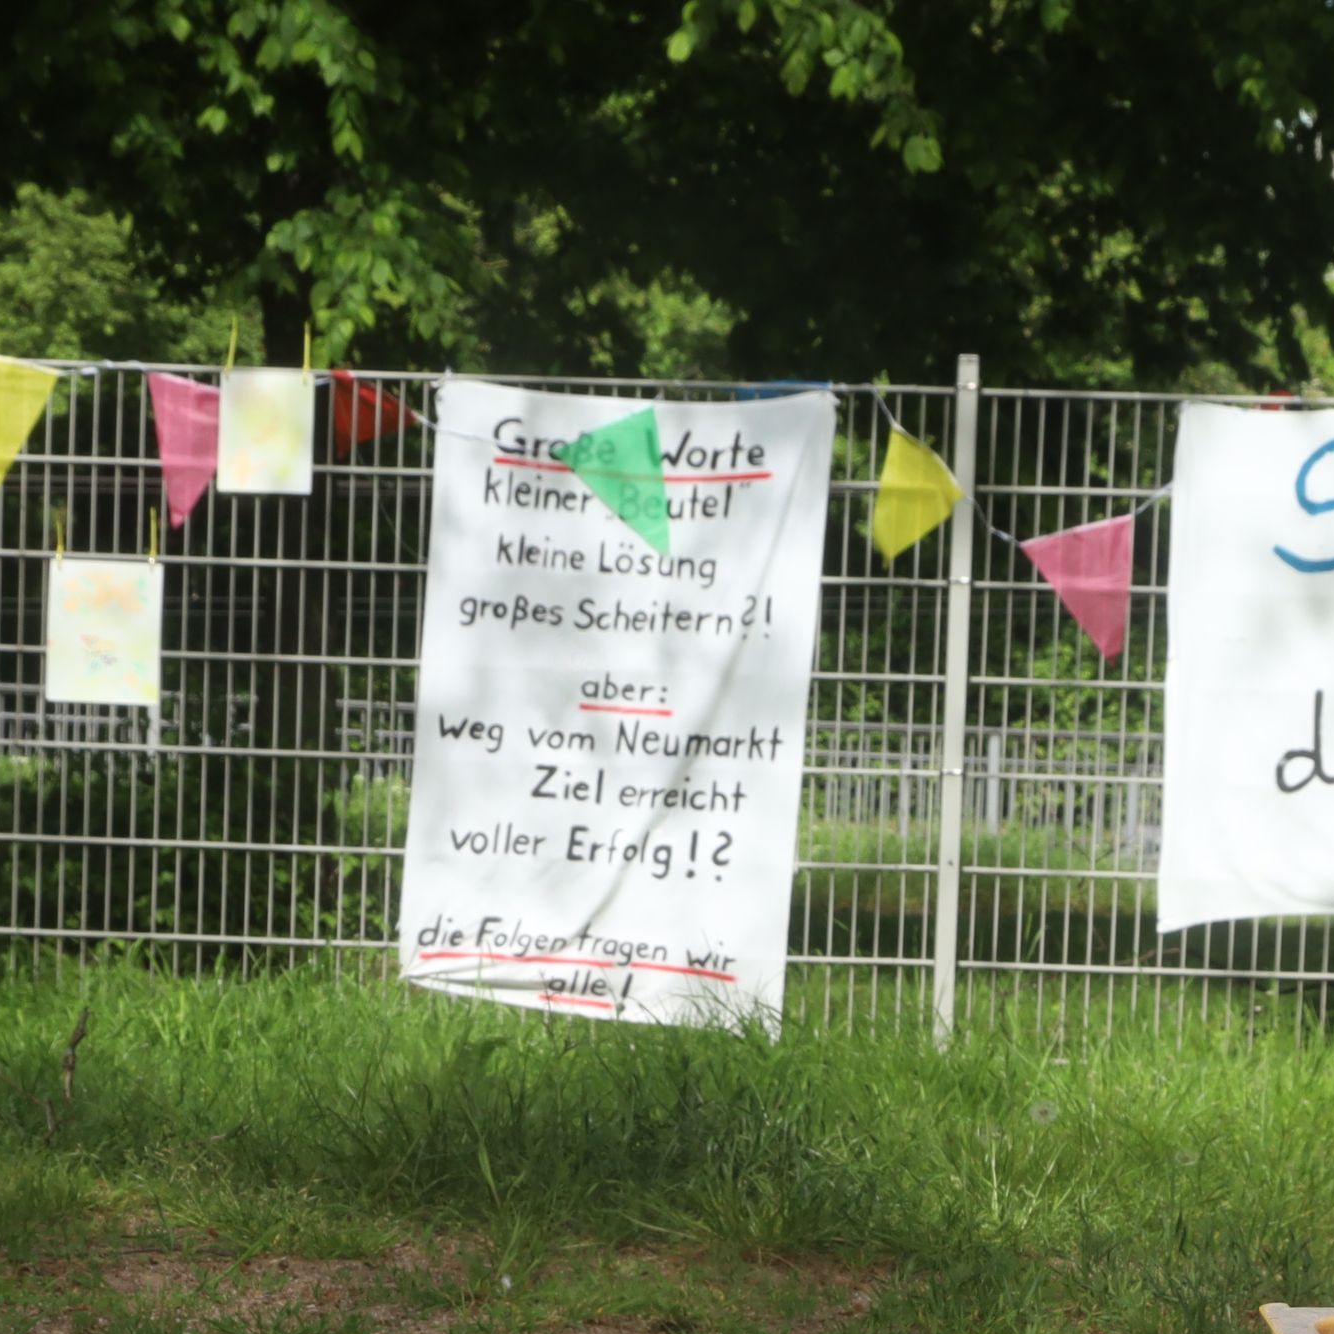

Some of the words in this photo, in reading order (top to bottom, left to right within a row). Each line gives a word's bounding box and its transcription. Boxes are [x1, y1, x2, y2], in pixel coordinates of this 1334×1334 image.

[493, 417, 617, 472] Große
[645, 429, 766, 471] Worte
[598, 540, 717, 588] Lösung
[460, 594, 565, 631] großes
[581, 672, 668, 703] aber:
[528, 726, 596, 752] vom
[616, 719, 785, 762] Neumarkt
[531, 764, 606, 805] Ziel
[619, 776, 748, 812] erreicht
[451, 822, 547, 856] voller
[417, 914, 465, 947] die
[475, 916, 568, 957] Folgen
[578, 921, 668, 967] tragen
